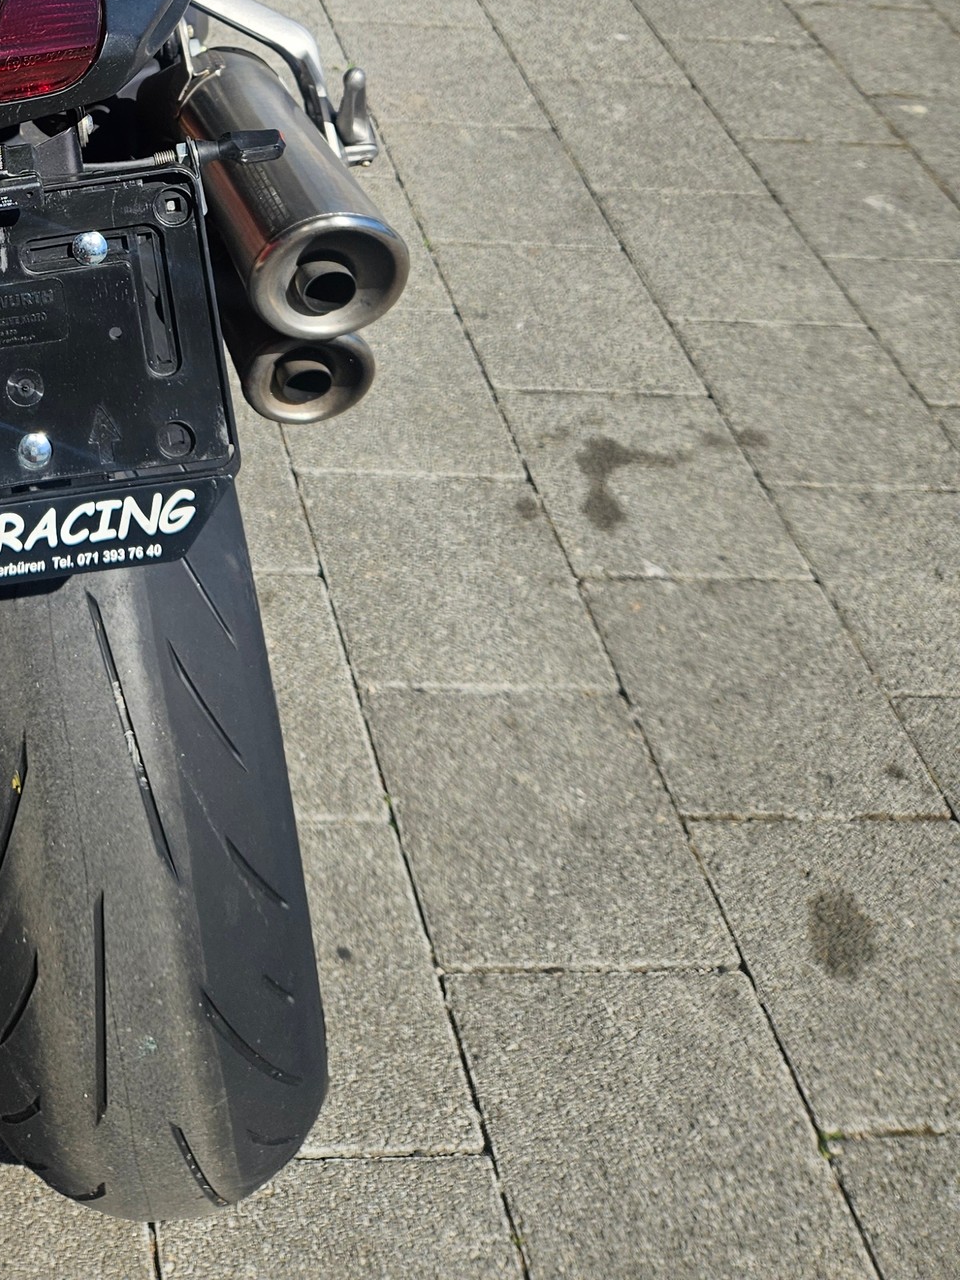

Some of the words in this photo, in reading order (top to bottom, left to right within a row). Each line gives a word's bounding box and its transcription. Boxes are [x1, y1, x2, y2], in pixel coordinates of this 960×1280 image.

[52, 554, 74, 570] Tel.
[76, 551, 99, 567] 071
[102, 548, 126, 564] 393
[128, 545, 144, 561] 76
[146, 543, 162, 558] 40
